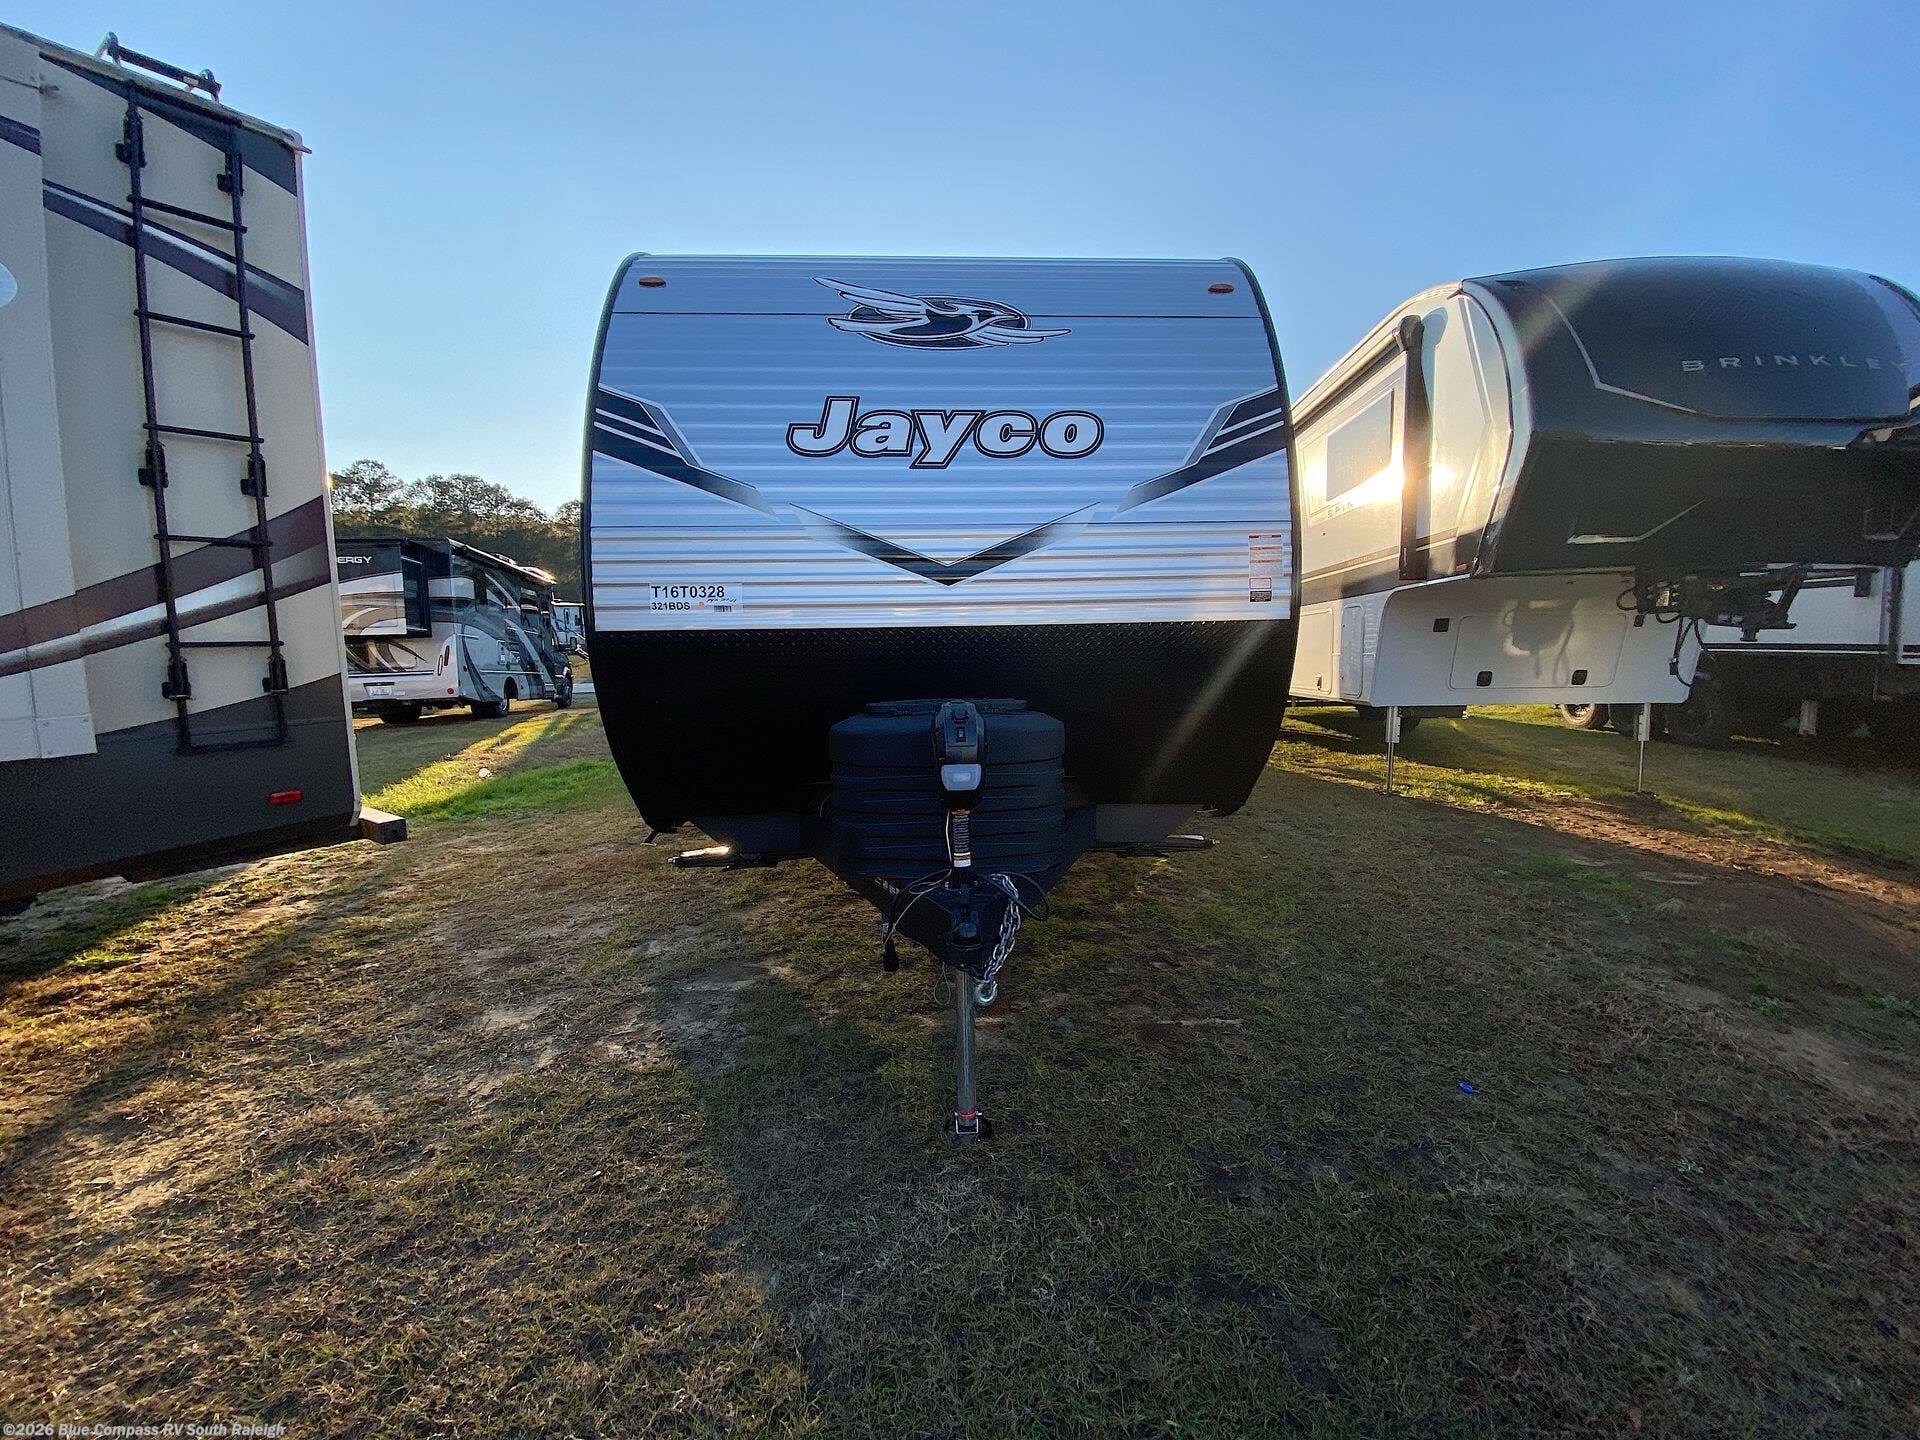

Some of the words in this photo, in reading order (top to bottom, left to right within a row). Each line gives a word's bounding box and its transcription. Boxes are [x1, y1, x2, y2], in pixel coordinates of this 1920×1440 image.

[1681, 355, 1909, 372] BRINKLEY
[786, 396, 1104, 469] Jayco
[651, 585, 725, 598] T16T0328
[651, 601, 691, 611] 321BDS
